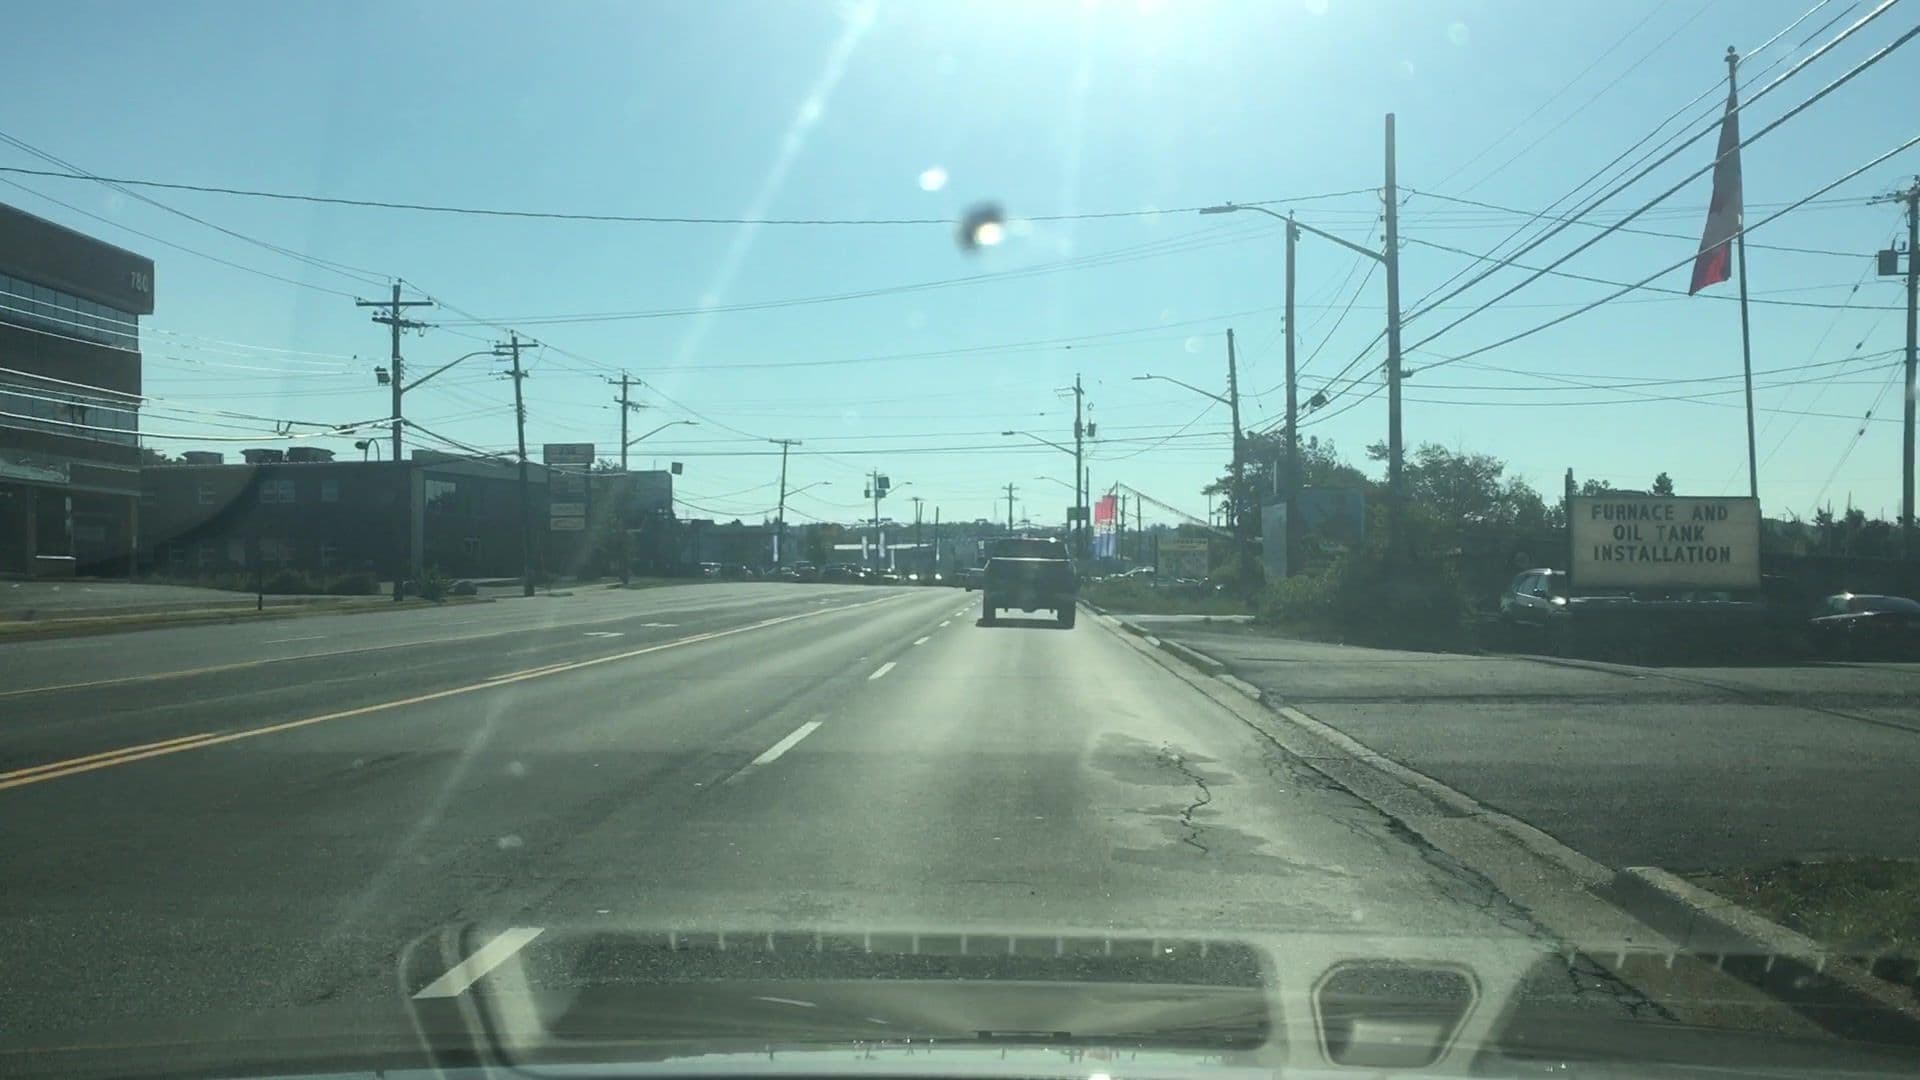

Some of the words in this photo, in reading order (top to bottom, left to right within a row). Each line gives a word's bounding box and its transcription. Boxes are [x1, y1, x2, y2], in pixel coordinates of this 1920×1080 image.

[1591, 504, 1674, 521] FURNACE
[1692, 505, 1728, 521] AND
[1613, 524, 1642, 541] OIL
[1656, 525, 1705, 542] TANK
[1594, 546, 1731, 563] INSTALLATION
